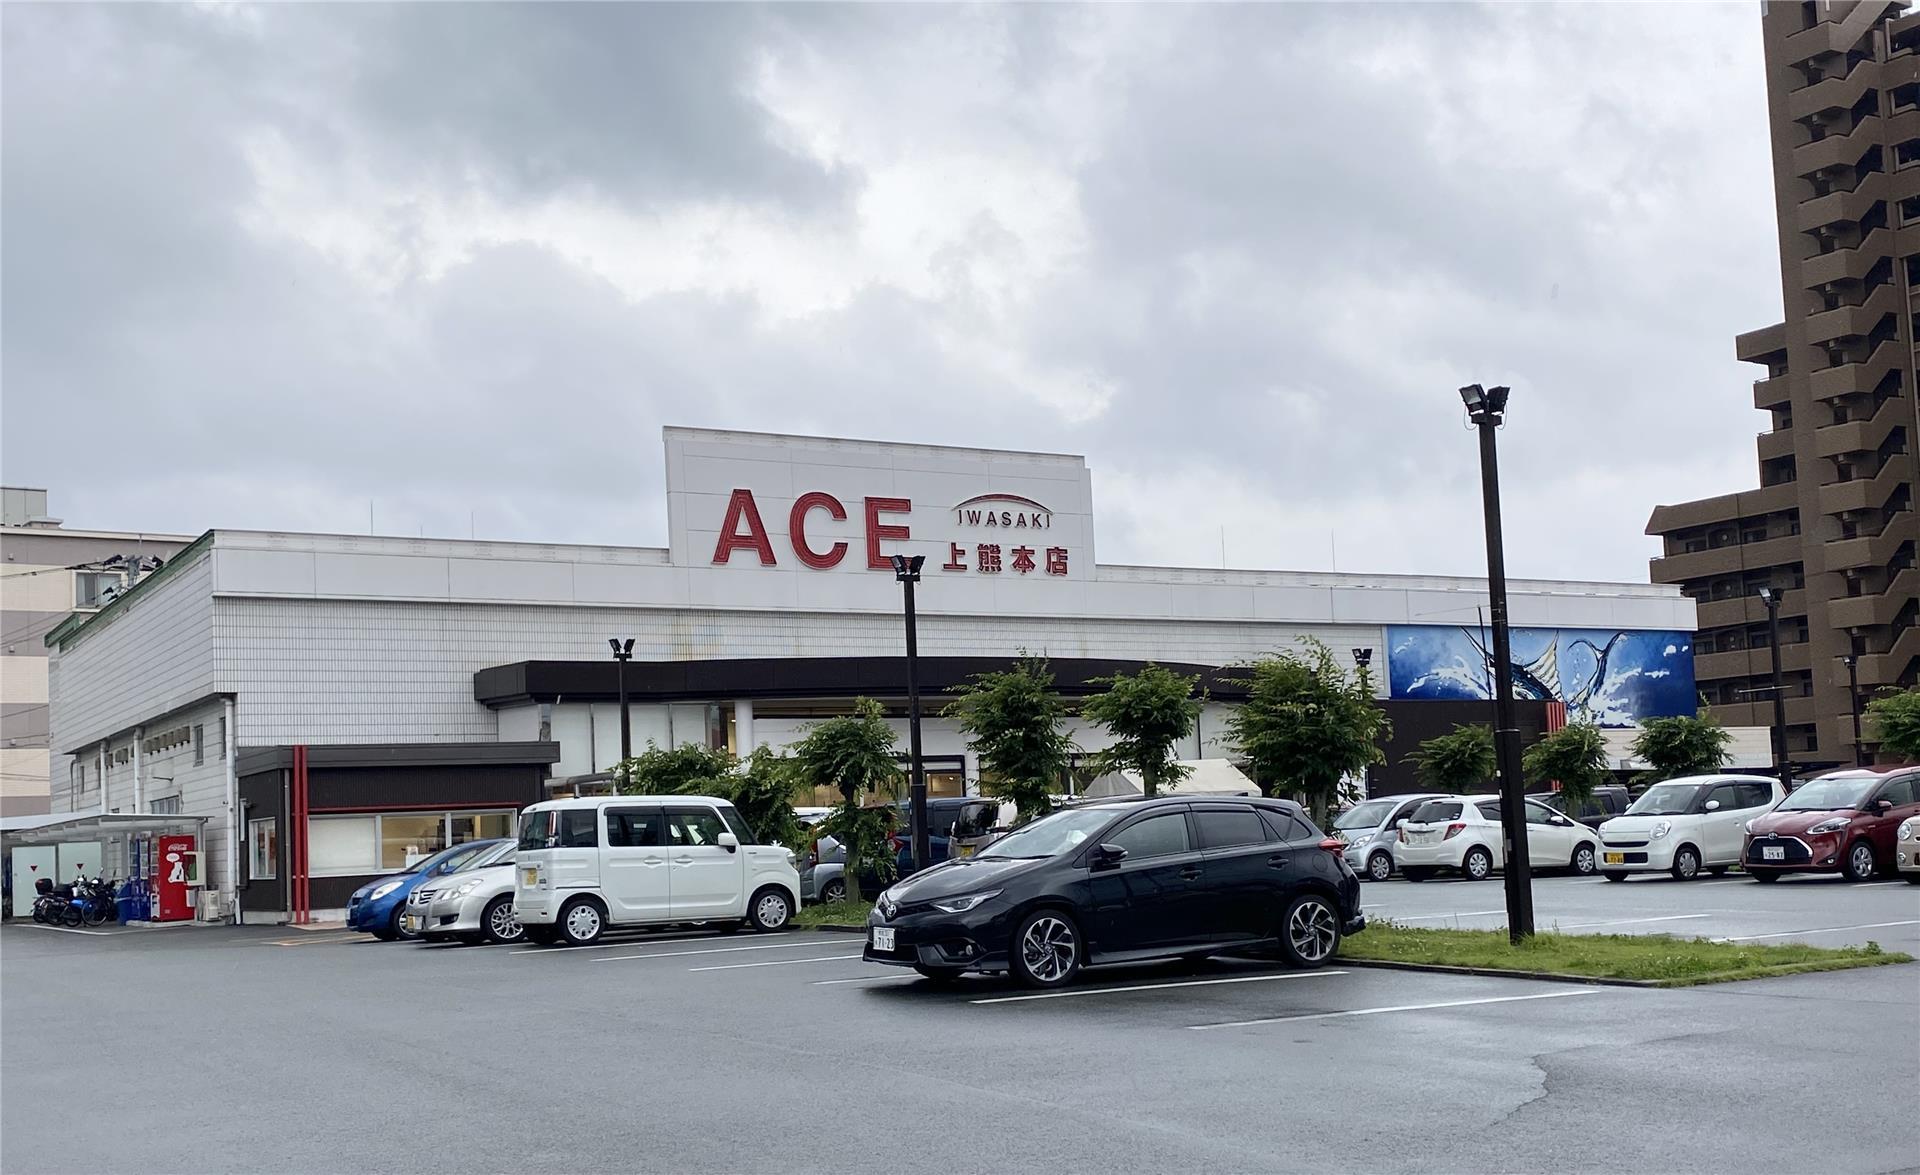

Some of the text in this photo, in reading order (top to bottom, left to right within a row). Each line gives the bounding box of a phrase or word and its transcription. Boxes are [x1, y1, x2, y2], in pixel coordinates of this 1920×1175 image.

[711, 488, 912, 570] ACE
[957, 509, 1051, 529] IWASAKI
[942, 542, 1068, 577] 上熊本店
